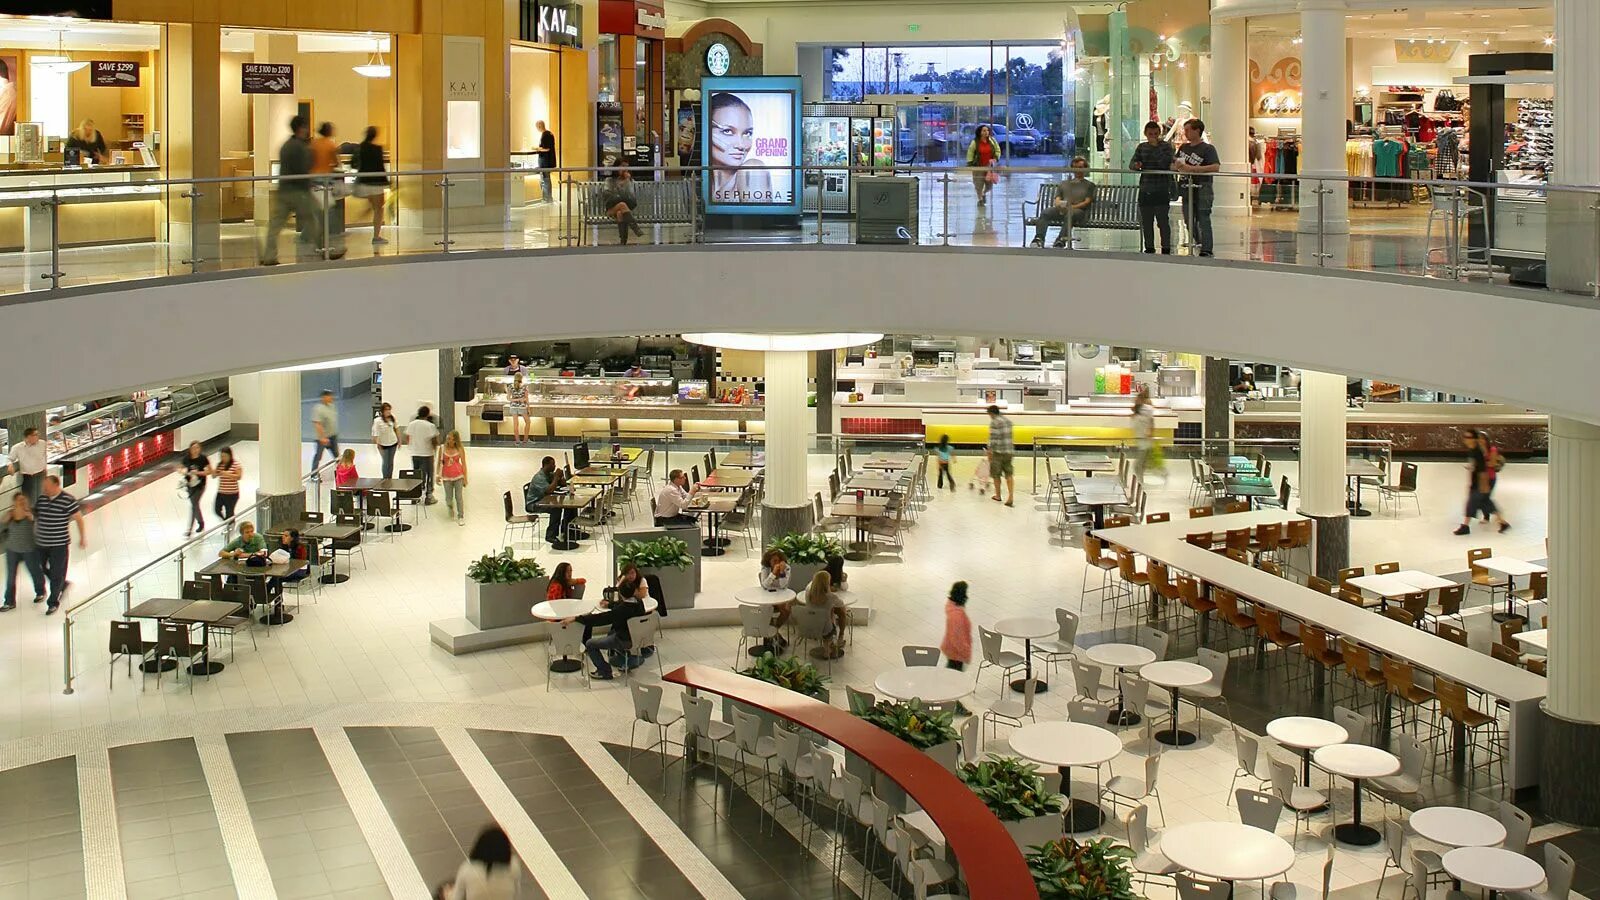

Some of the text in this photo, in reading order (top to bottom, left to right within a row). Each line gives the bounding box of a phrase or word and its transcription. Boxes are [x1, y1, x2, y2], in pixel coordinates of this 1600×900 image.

[539, 5, 567, 33] KAY
[98, 62, 135, 71] SAVE $299
[245, 64, 291, 74] SAVE $100 to $200
[450, 81, 477, 91] KAY
[755, 137, 788, 149] GRAND
[755, 148, 788, 157] OPENING
[715, 190, 782, 200] SEPHORA
